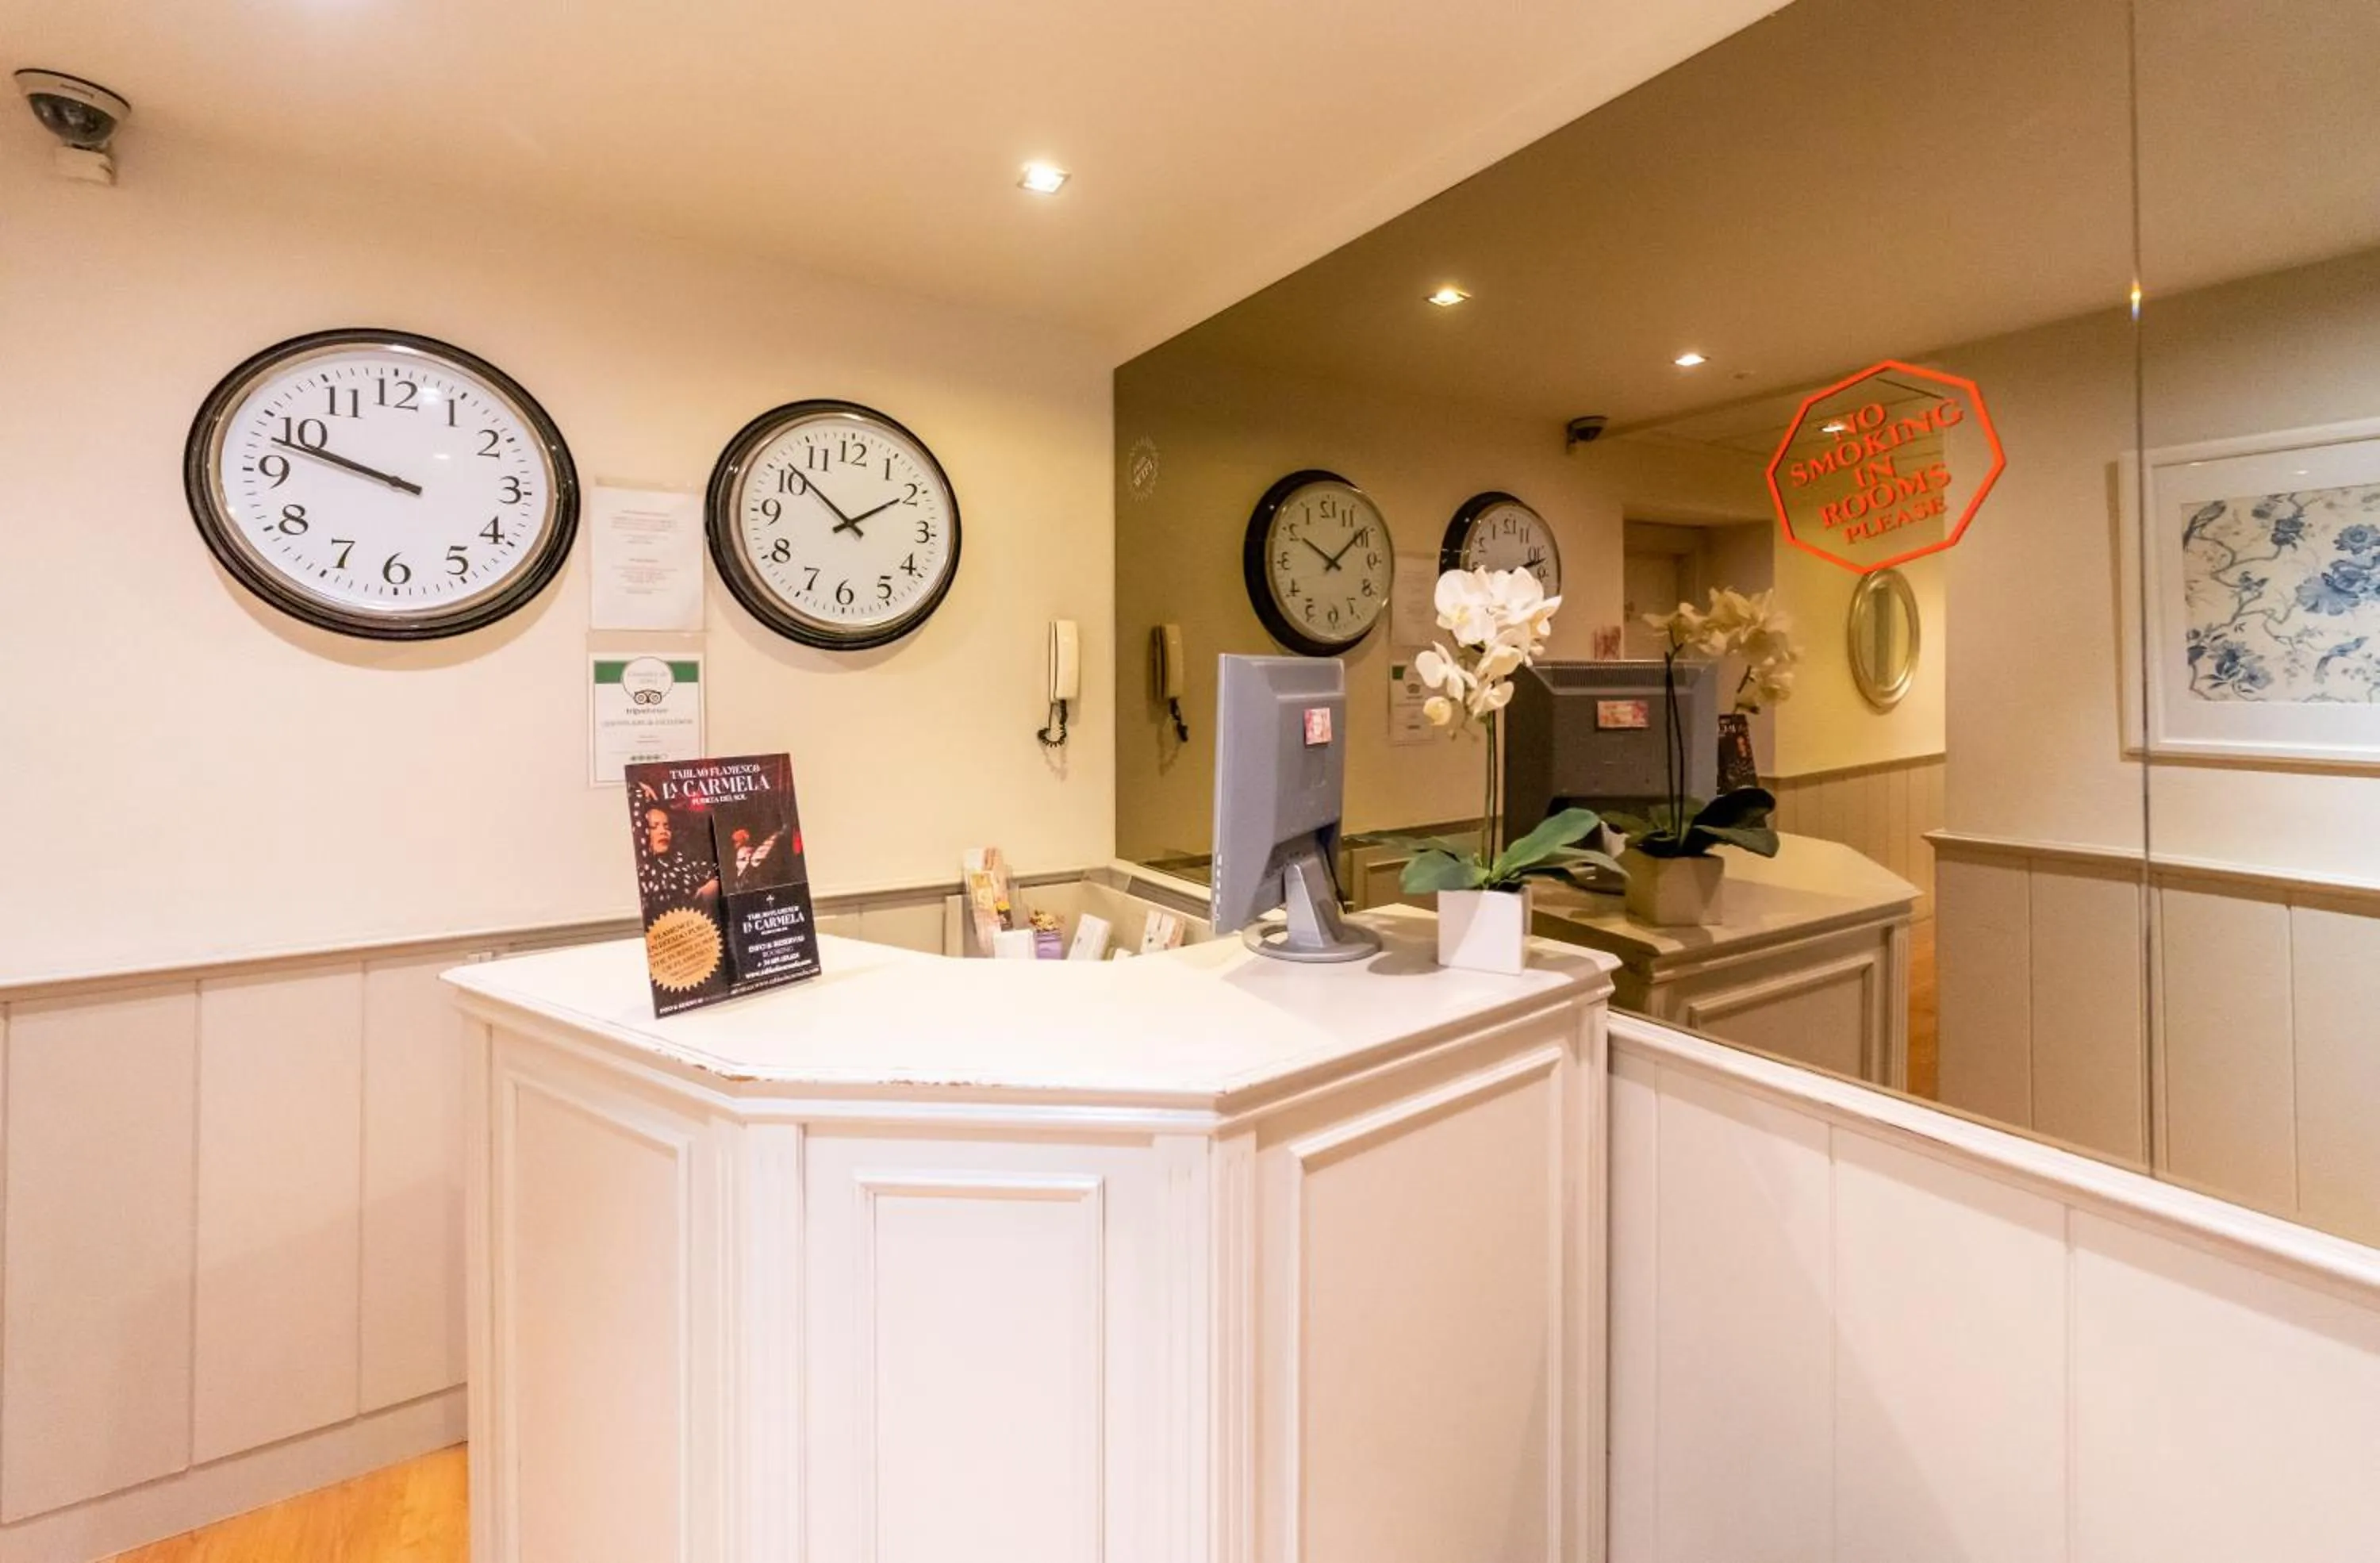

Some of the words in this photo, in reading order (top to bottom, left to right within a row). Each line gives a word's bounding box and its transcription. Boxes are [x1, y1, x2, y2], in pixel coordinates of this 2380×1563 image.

[325, 386, 362, 418] 11
[374, 378, 419, 410] 12
[447, 398, 459, 427] 1
[1829, 403, 1887, 441] NO
[281, 417, 328, 449] 10
[477, 429, 501, 457] 2
[1790, 398, 1964, 487] SMOKING
[808, 446, 831, 471] 11
[839, 440, 867, 467] 12
[259, 455, 290, 488] 9
[778, 470, 807, 496] 10
[885, 458, 893, 481] 1
[1854, 455, 1897, 488] IN
[501, 476, 520, 504] 3
[902, 483, 918, 506] 2
[1820, 463, 1952, 528] ROOMS
[278, 504, 309, 535] 8
[762, 498, 781, 525] 9
[1843, 496, 1948, 545] PLEASE
[479, 517, 505, 543] 4
[915, 520, 929, 543] 3
[331, 539, 355, 568] 7
[446, 545, 468, 574] 5
[771, 538, 791, 563] 8
[900, 553, 917, 575] 4
[382, 552, 411, 584] 6
[804, 567, 820, 590] 7
[836, 579, 854, 605] 6
[877, 575, 892, 599] 5
[683, 774, 770, 798] CARMELA
[754, 912, 804, 931] CARMELA
